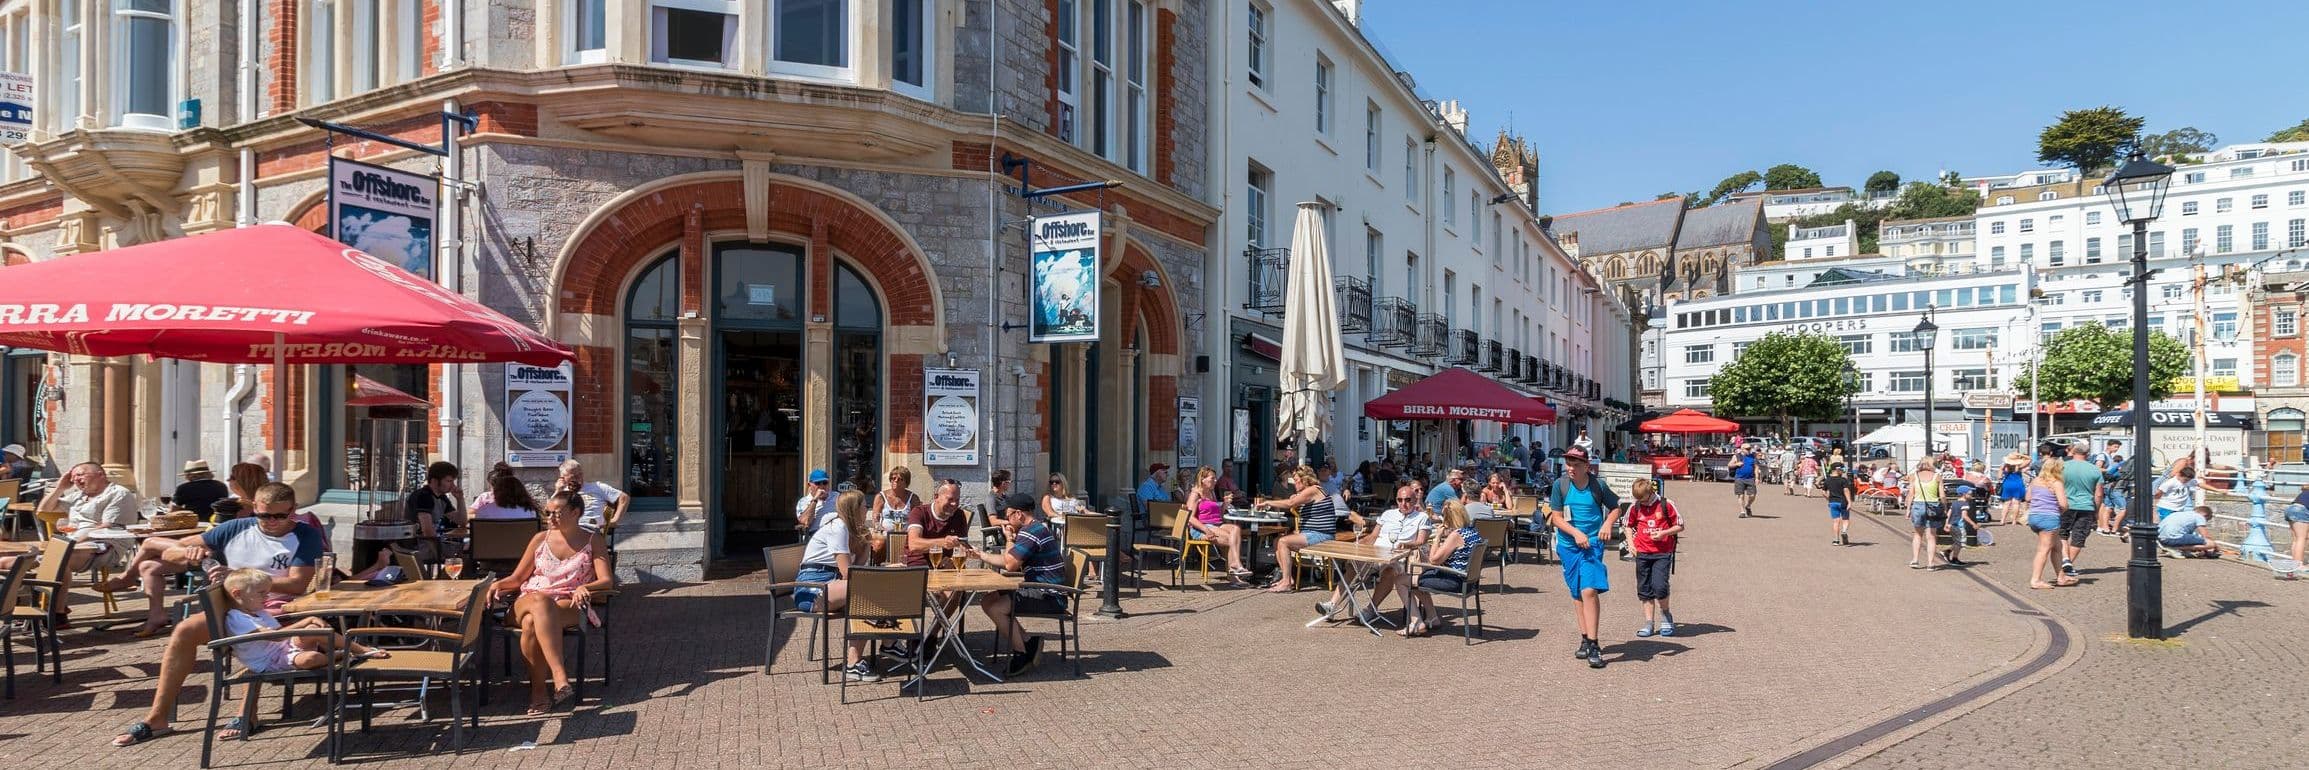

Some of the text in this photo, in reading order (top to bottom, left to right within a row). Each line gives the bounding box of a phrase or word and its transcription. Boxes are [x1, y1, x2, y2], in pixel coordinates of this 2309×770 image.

[352, 170, 422, 204] Offshore
[1042, 220, 1088, 240] Offshore
[105, 303, 315, 325] MORETTI
[1785, 319, 1867, 335] HOOPERS
[517, 367, 561, 380] Offshore
[935, 375, 970, 387] Offshore
[1403, 404, 1512, 418] BIRRA MORETTI
[2093, 414, 2123, 425] COFFEE
[2151, 412, 2221, 424] OFFE
[1940, 423, 1968, 432] CRAB
[1990, 433, 2020, 449] EAFOOD
[2163, 433, 2236, 442] SALCOM DAIRY
